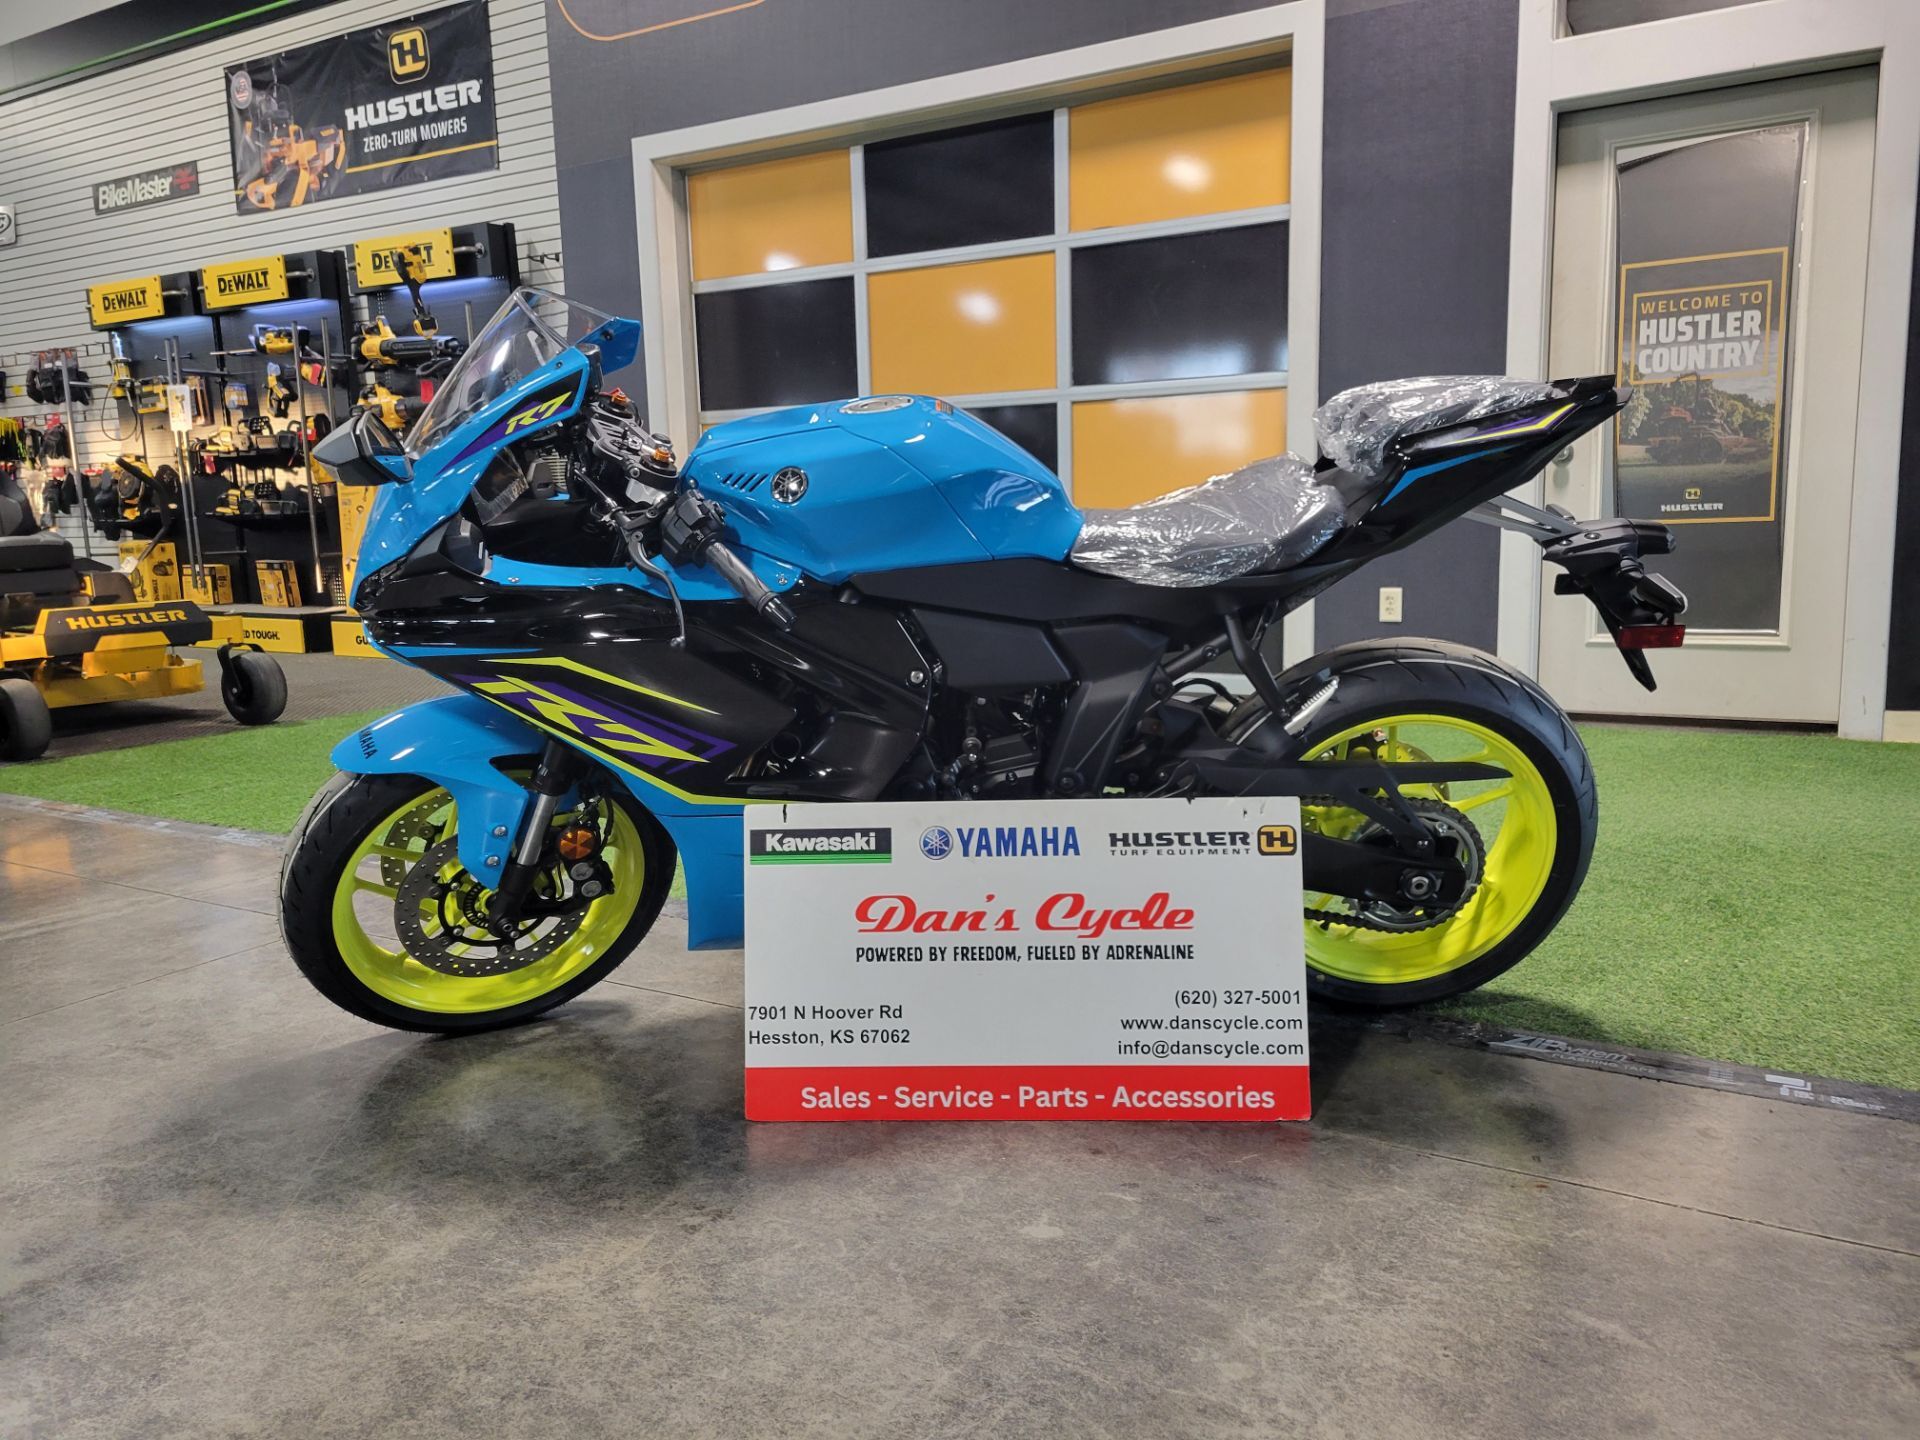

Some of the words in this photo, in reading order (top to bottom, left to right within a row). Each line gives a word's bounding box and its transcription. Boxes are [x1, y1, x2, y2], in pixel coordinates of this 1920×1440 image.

[345, 79, 483, 131] HUSTLER
[363, 131, 418, 153] ZERO-TURN
[420, 116, 468, 141] MOWERS
[98, 175, 173, 210] BikeMaster
[371, 245, 433, 271] DET
[1641, 294, 1731, 314] WELCOME
[1739, 291, 1763, 304] TO
[1638, 309, 1762, 346] HUSTLER
[1637, 339, 1760, 374] COUNTRY
[504, 391, 572, 436] R7
[1660, 503, 1724, 512] HUSTLER
[65, 609, 188, 630] HUSTLER
[765, 832, 876, 852] Kawasaki
[956, 827, 1081, 857] YAMAHA
[1109, 831, 1251, 848] HUSTLER
[1157, 848, 1251, 856] EQUIPMENT
[855, 894, 1020, 933] Dan's
[1035, 892, 1194, 938] Cycle
[856, 946, 923, 963] POWERED
[929, 946, 947, 962] BY
[953, 945, 1022, 963] FREEDOM,
[1027, 945, 1076, 961] FUELED
[1082, 945, 1100, 960] BY
[1106, 944, 1195, 960] ADRENALINE
[1174, 990, 1218, 1008] (620)
[1223, 990, 1301, 1005] 327-5001
[749, 1006, 787, 1020] 7901
[794, 1005, 806, 1019] N
[812, 1005, 874, 1019] Hoover
[879, 1004, 903, 1019] Rd
[1120, 1015, 1303, 1033] www.danscycle.com
[749, 1030, 825, 1047] Hesston,
[830, 1029, 855, 1044] KS
[860, 1029, 911, 1044] 67062
[1118, 1040, 1304, 1058] info@danscycle.com
[1624, 1064, 1657, 1074] TAPE
[801, 1086, 872, 1109] Sales
[894, 1085, 994, 1108] Service
[1018, 1086, 1089, 1108] Parts
[1112, 1085, 1276, 1108] Accessories
